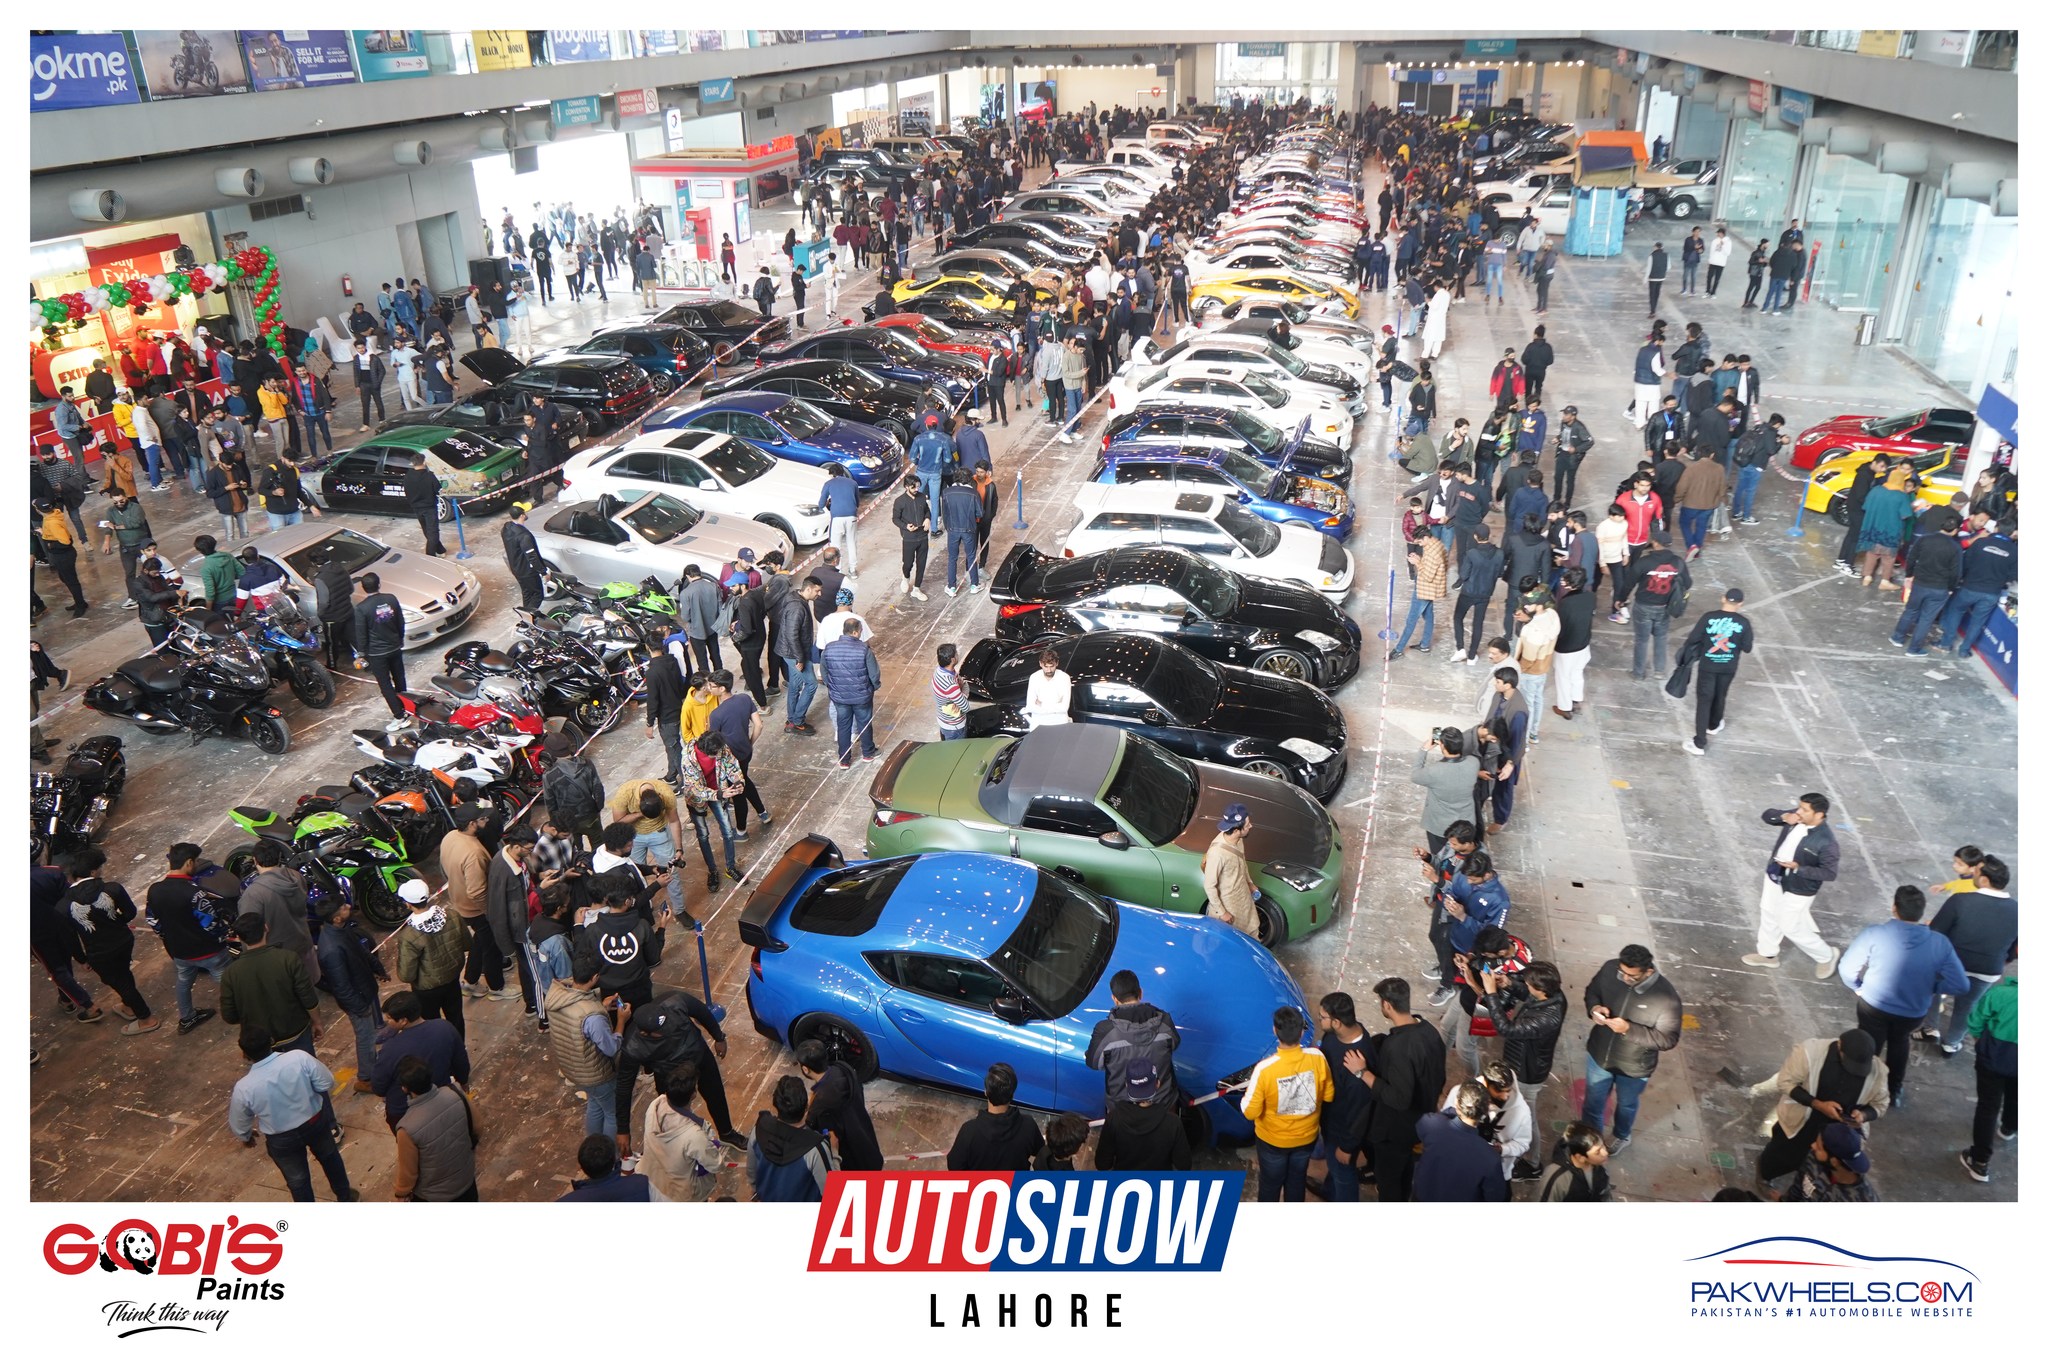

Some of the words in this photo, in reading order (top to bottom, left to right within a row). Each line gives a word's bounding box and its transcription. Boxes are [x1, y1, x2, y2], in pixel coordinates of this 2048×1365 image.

[296, 47, 314, 57] SELL
[315, 46, 322, 55] IT
[30, 45, 126, 80] okme
[298, 56, 313, 65] FOR
[313, 55, 325, 64] ME
[107, 77, 128, 95] .pk
[704, 86, 720, 97] STAIRS
[565, 106, 591, 116] CONVENTION
[571, 114, 588, 123] CENTER
